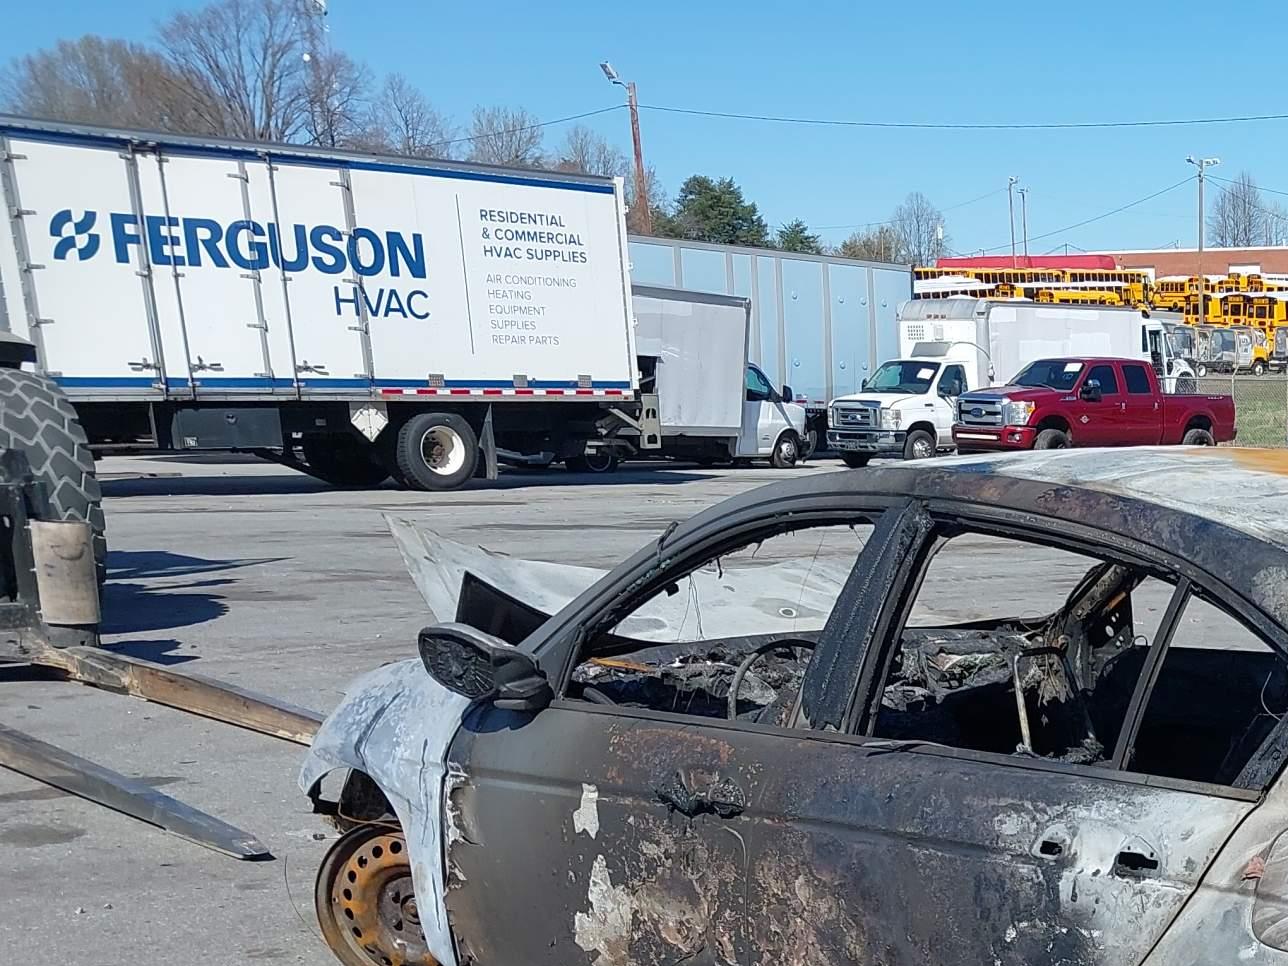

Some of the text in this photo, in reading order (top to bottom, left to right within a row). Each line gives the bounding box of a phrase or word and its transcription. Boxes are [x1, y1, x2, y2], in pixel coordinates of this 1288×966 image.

[480, 209, 566, 228] RESIDENTIAL
[481, 227, 585, 246] & COMMERCIAL
[109, 212, 427, 279] FERGUSON
[483, 245, 588, 264] HVAC SUPPLIES
[486, 274, 577, 288] AIR CONDITIONING
[333, 285, 430, 320] HVAC
[487, 289, 532, 301] HEATING
[489, 304, 546, 316] EQUIPMENT
[490, 319, 537, 331] SUPPLIES
[492, 334, 560, 346] REPAIR PARTS
